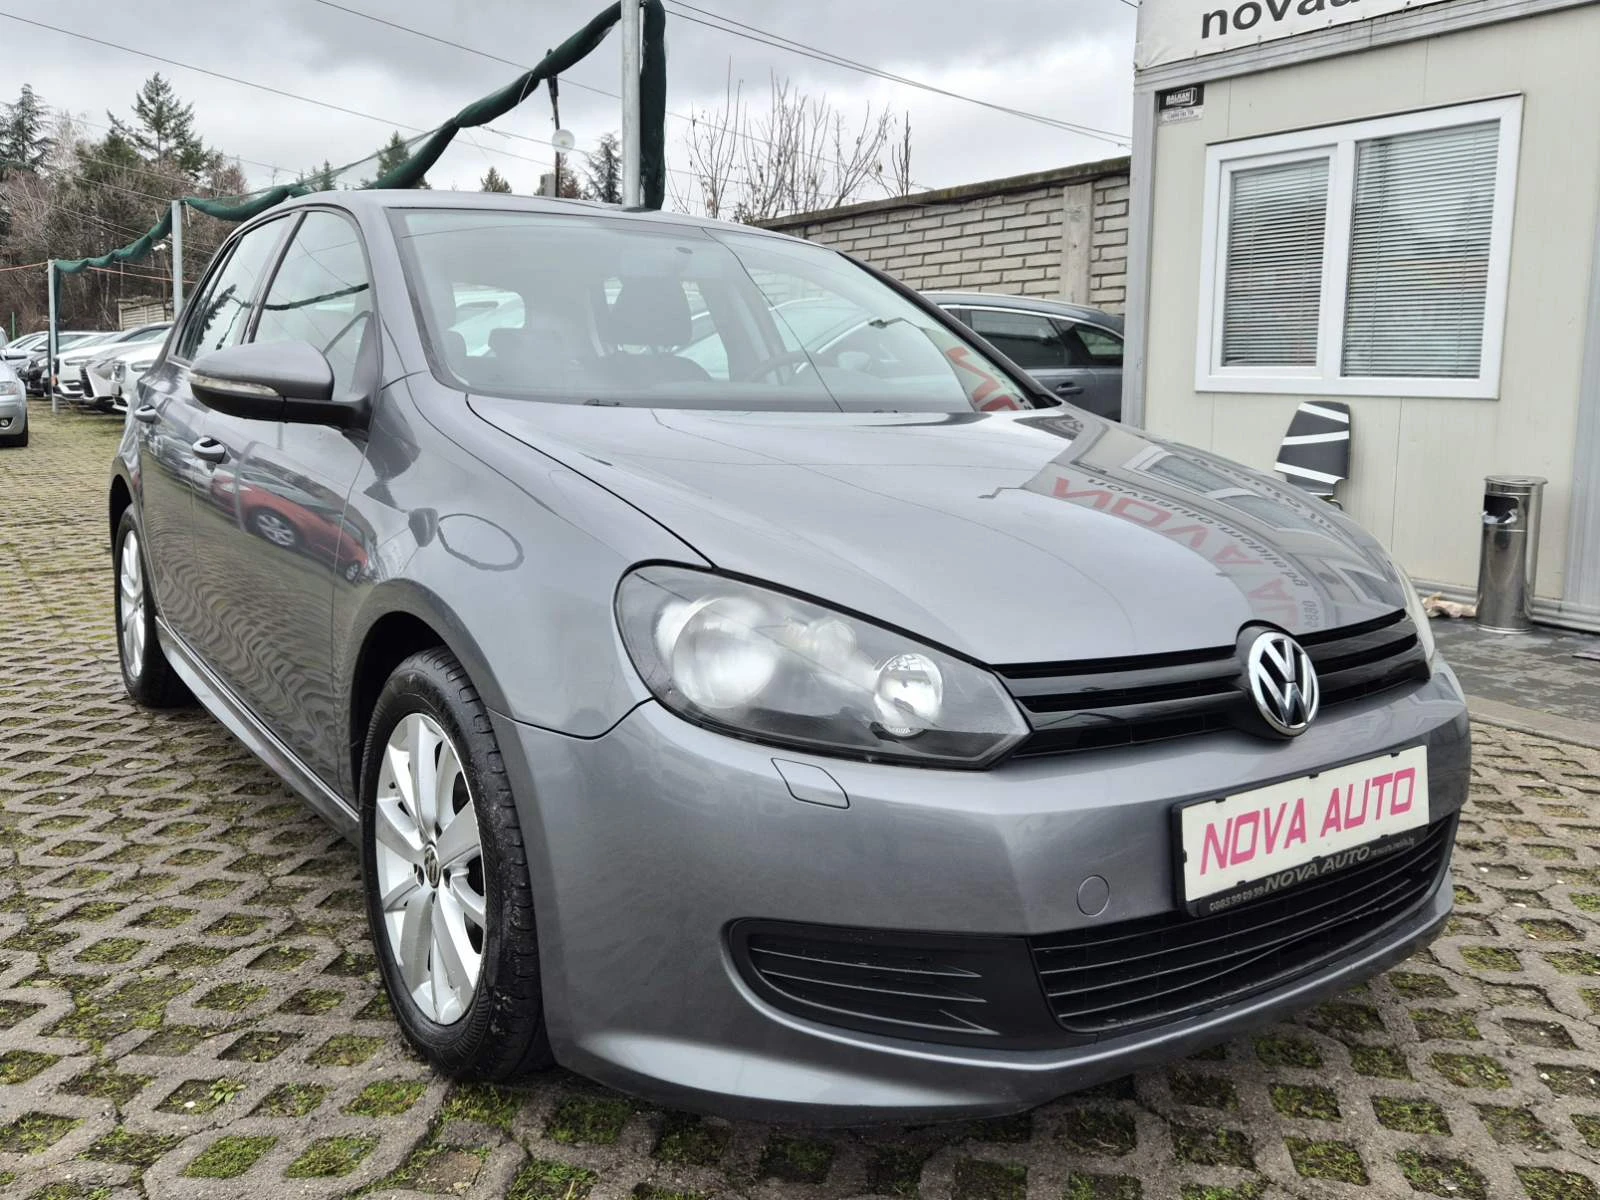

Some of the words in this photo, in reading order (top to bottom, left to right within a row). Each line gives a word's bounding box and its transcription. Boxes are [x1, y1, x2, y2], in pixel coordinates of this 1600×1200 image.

[1201, 0, 1360, 39] nova
[1200, 797, 1307, 876] NOVA
[1319, 767, 1416, 838] AUTO
[1264, 863, 1319, 892] NOVA
[1320, 846, 1370, 874] AUTO
